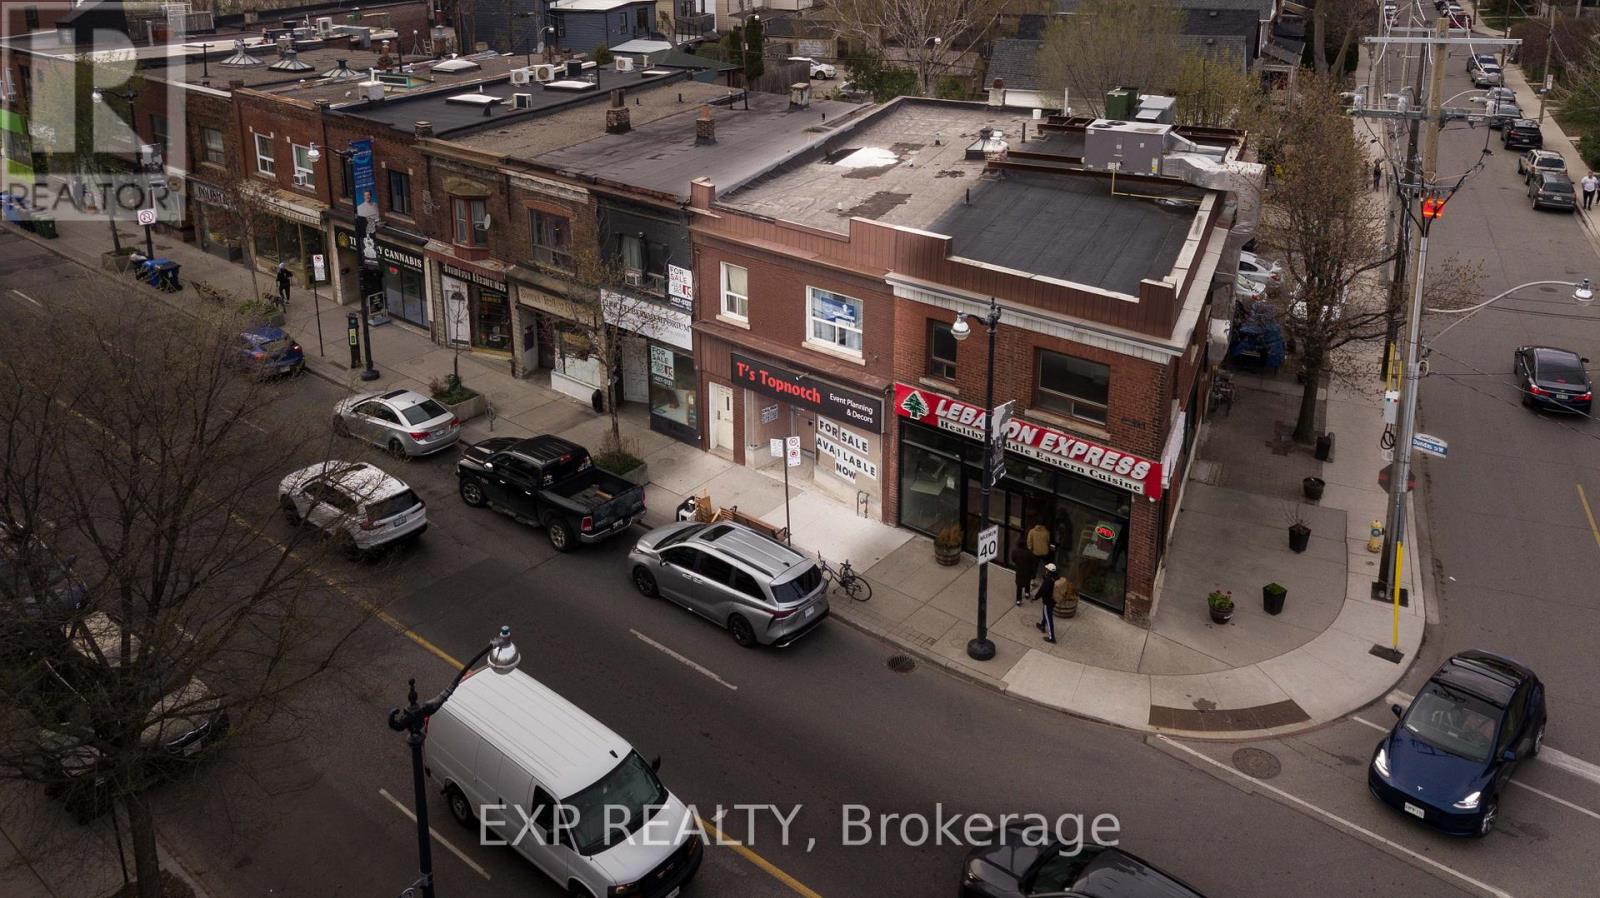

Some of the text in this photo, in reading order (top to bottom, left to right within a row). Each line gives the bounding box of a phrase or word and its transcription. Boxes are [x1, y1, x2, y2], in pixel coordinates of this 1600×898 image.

[384, 248, 422, 268] CANNABIS
[670, 266, 683, 275] FOR
[670, 273, 687, 284] SALE
[652, 346, 665, 356] FOR
[652, 353, 668, 364] SALE
[737, 361, 821, 404] T's Topnotch
[830, 393, 873, 415] Event Planning
[852, 411, 873, 424] Decors
[819, 420, 868, 453] FOR SALE
[935, 399, 1151, 480] LEBAON EXPRESS
[1412, 438, 1433, 449] Dundas
[817, 438, 876, 477] AVAILABLE
[940, 420, 985, 440] Healthy
[1036, 449, 1084, 473] Eastern
[1090, 469, 1141, 492] Cuisine
[836, 463, 857, 479] NOW
[1095, 527, 1114, 537] OPEN
[979, 540, 996, 558] 40
